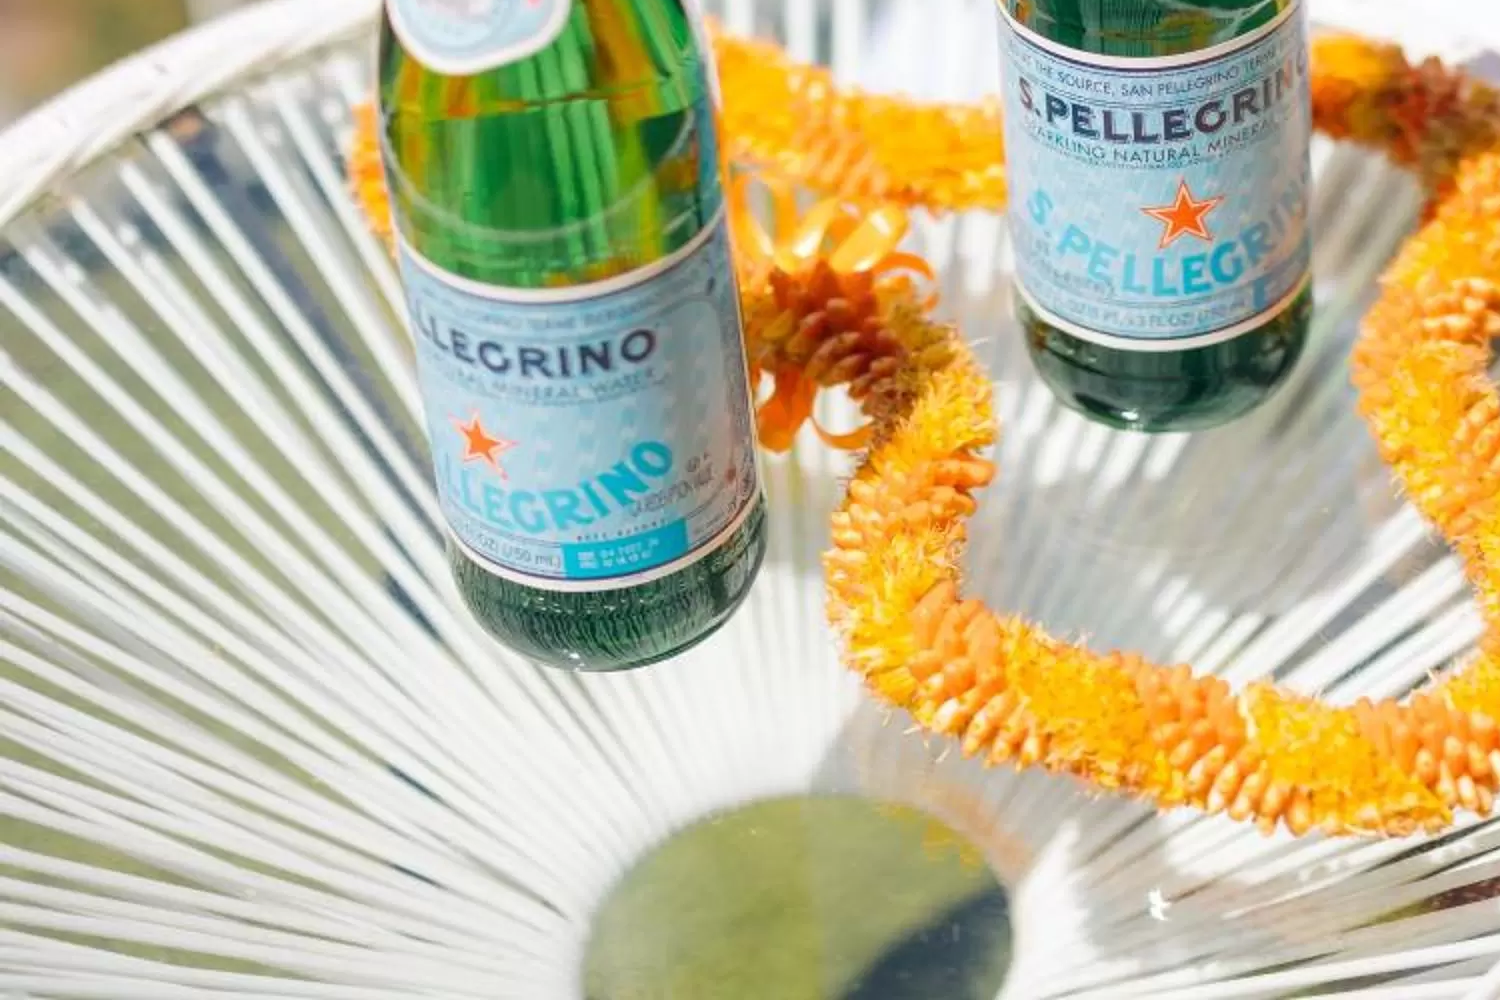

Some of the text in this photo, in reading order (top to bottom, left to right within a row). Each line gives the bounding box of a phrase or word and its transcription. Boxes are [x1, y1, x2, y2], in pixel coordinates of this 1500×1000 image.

[1121, 83, 1153, 97] SAN
[1158, 65, 1239, 96] PELLEGRINO
[1113, 147, 1200, 163] NATURAL
